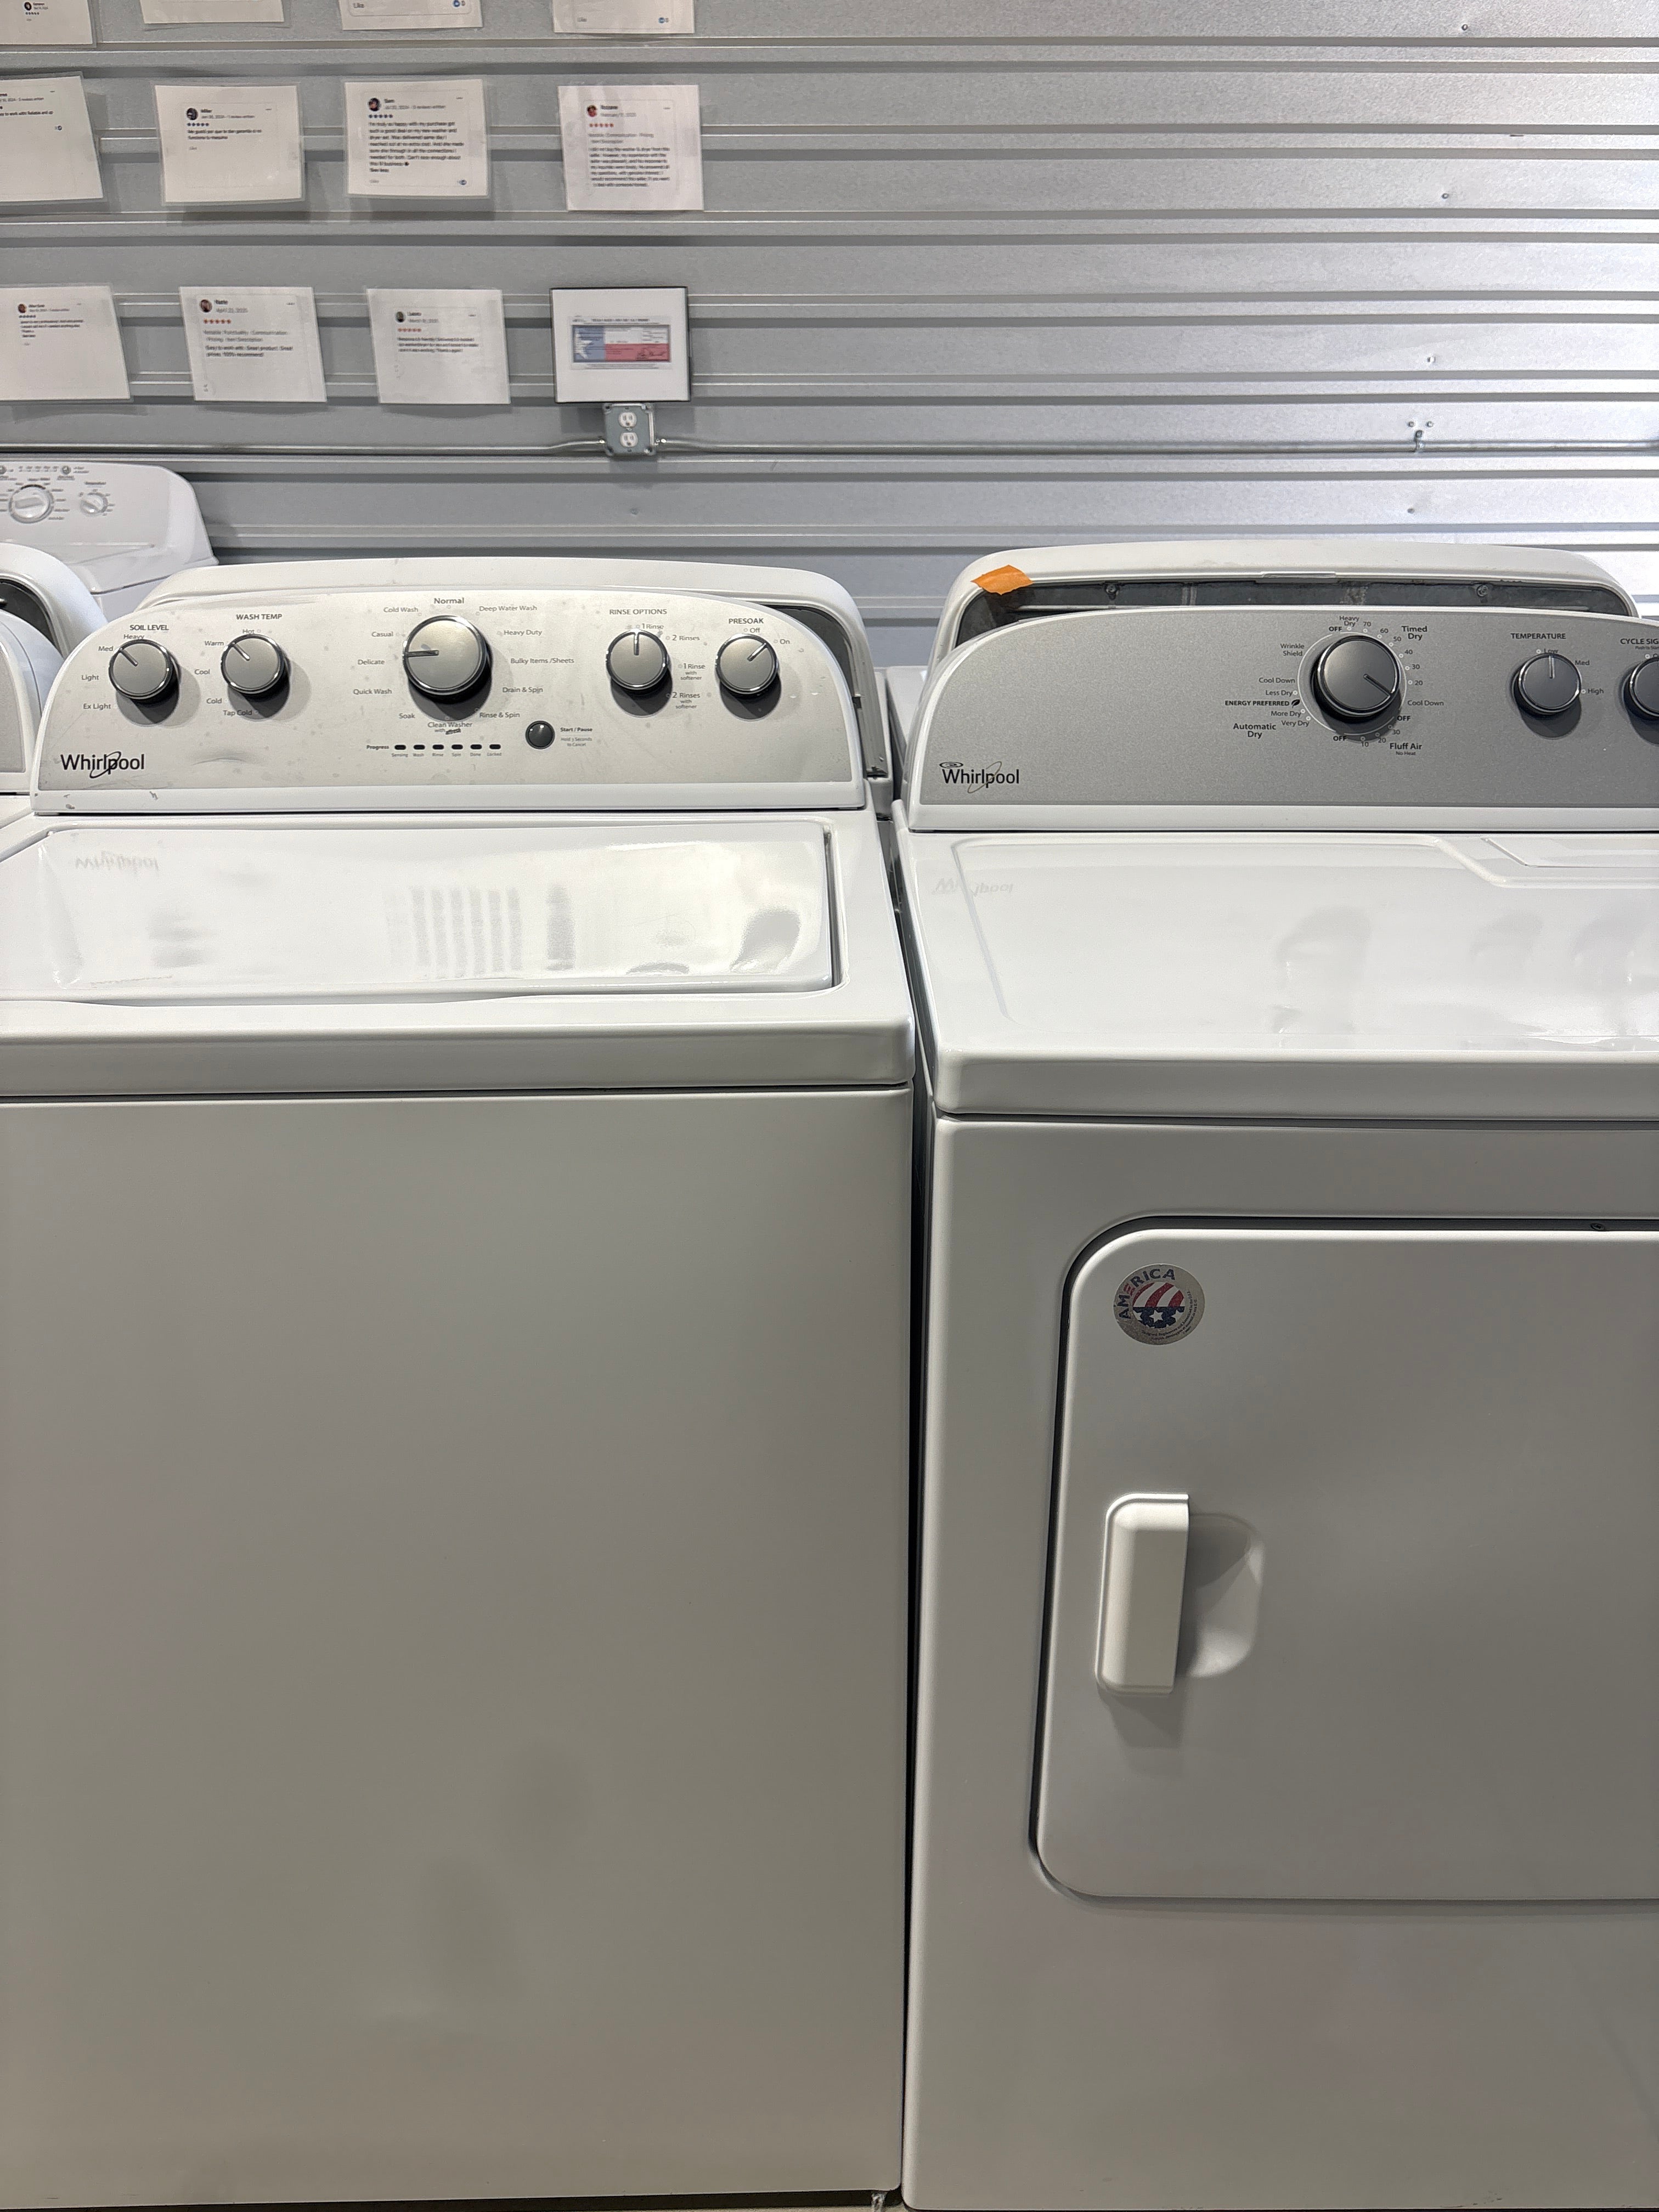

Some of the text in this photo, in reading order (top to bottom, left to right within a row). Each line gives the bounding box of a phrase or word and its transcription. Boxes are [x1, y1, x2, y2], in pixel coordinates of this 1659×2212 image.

[1407, 633, 1423, 641] Dry
[1247, 730, 1262, 739] Dry
[60, 752, 144, 777] Whirlpool
[941, 765, 1019, 791] Whirlpool
[1117, 1268, 1176, 1319] AMERICA
